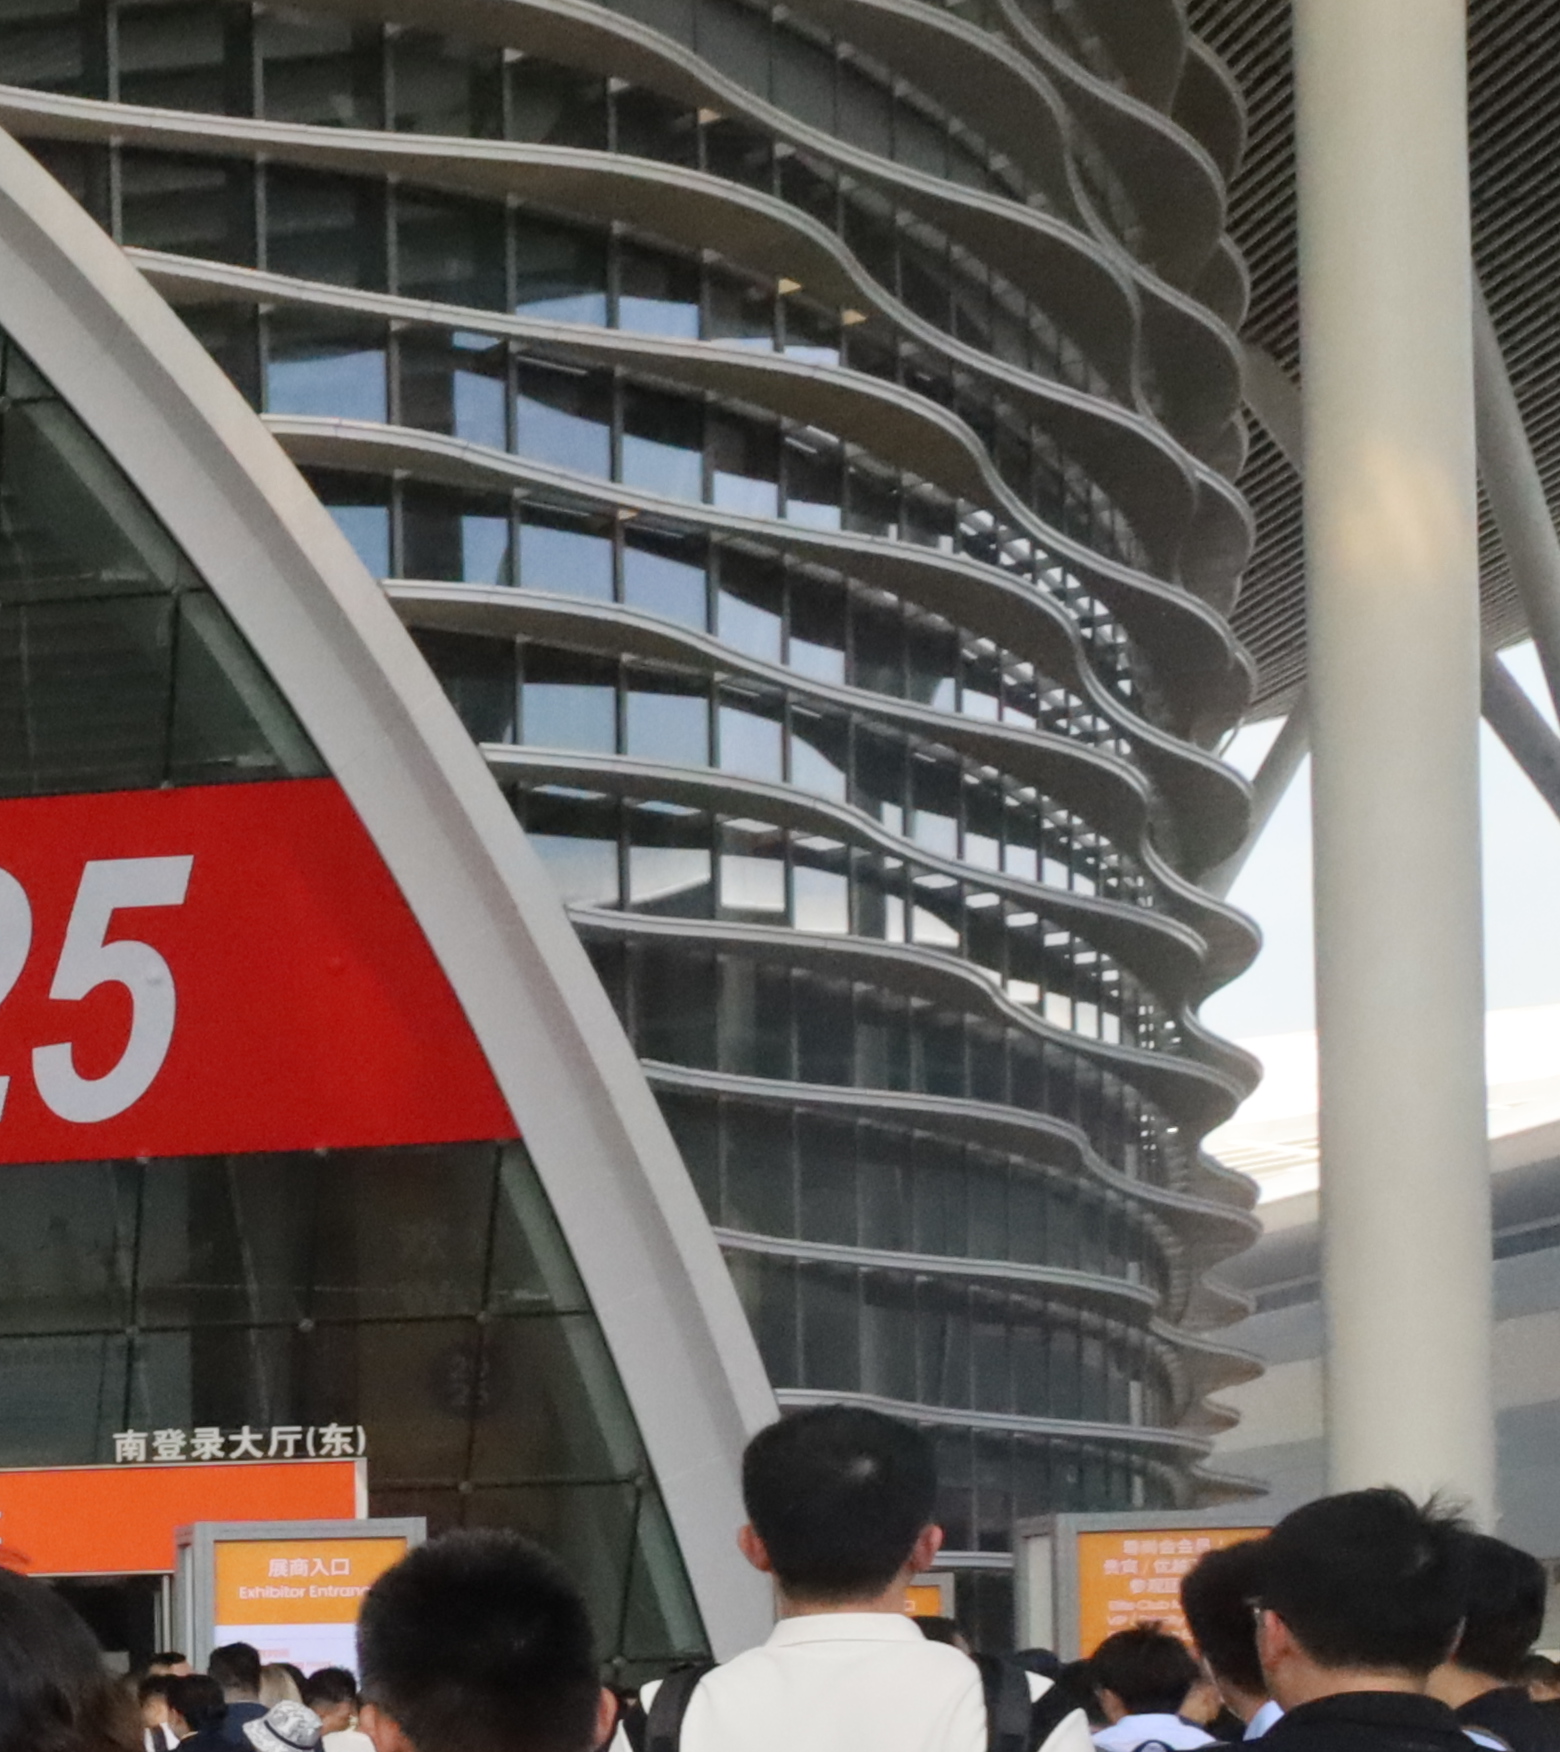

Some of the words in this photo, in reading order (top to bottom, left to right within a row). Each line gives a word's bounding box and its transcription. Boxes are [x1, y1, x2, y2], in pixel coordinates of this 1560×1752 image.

[112, 1422, 368, 1463] 南登录大厅(东)
[268, 1557, 351, 1578] 展商入口
[238, 1585, 306, 1600] Exhibitor
[309, 1584, 371, 1599] Entranc
